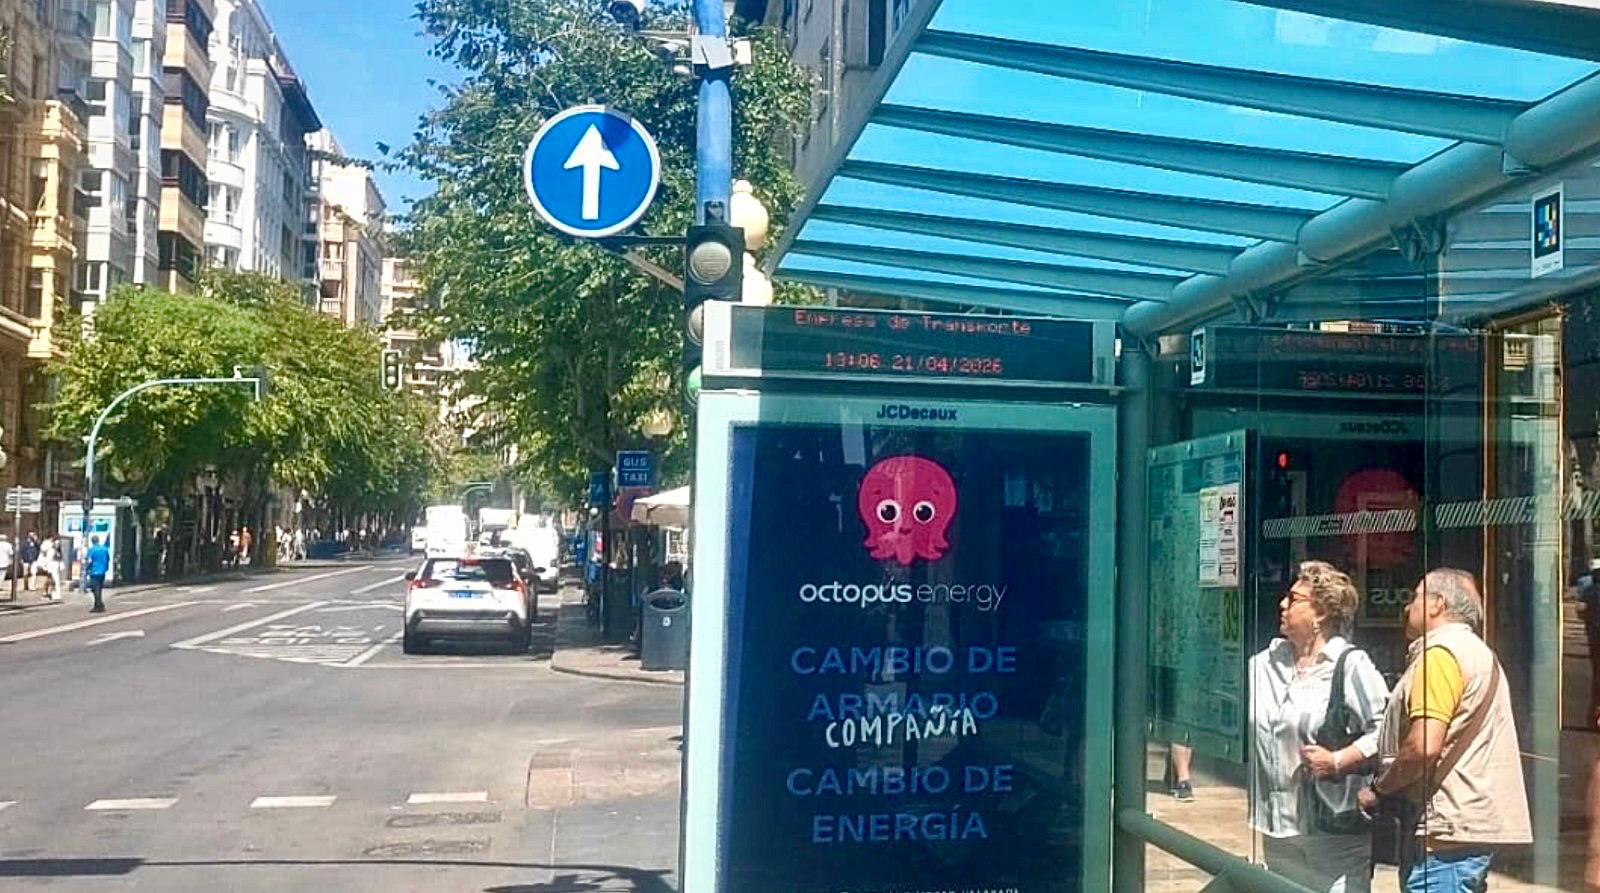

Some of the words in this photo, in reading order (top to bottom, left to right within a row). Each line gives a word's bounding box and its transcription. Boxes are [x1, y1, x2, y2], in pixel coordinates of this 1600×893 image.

[889, 315, 909, 330] de
[825, 353, 880, 369] 13:06
[892, 355, 1003, 374] 21/04/2026
[876, 404, 957, 420] JCDecaux
[623, 473, 648, 484] TAXI
[799, 581, 912, 608] octopus
[916, 584, 1007, 611] energy
[791, 646, 954, 674] CAMBIO
[967, 646, 1017, 673] DE
[807, 692, 998, 721] ARMARIO
[786, 767, 949, 796] CAMBIO
[964, 764, 1014, 793] DE
[812, 804, 988, 843] ENERGÍA
